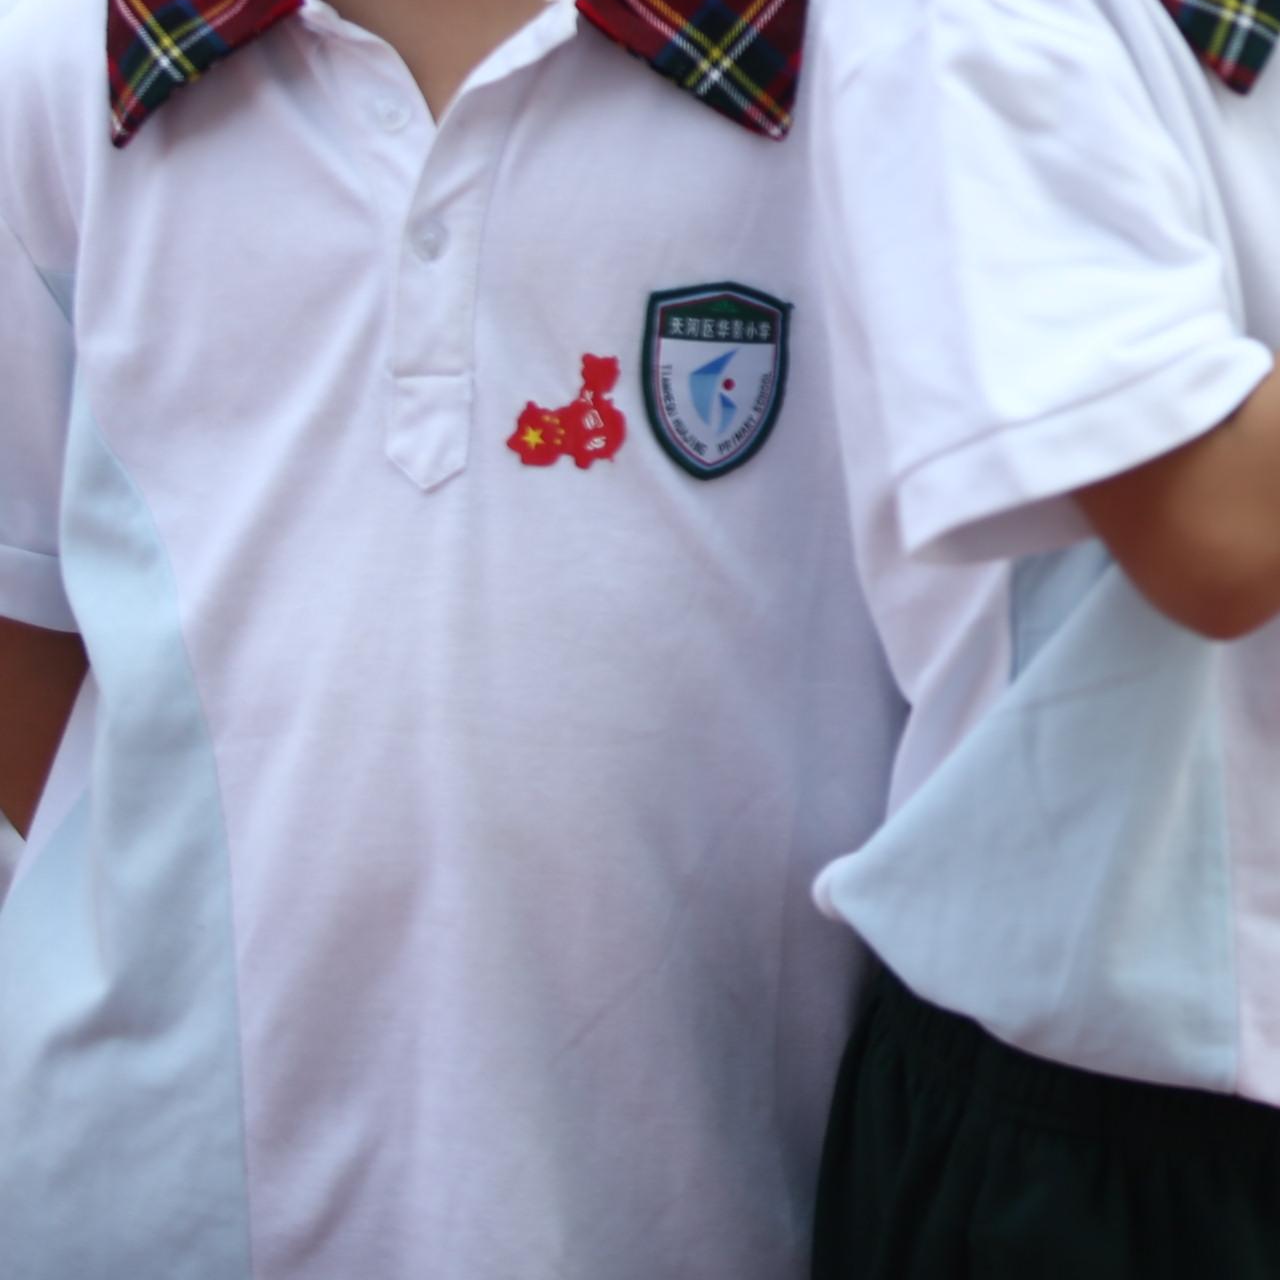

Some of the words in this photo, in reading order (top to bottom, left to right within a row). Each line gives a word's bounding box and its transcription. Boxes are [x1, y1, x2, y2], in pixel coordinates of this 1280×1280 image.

[670, 317, 772, 340] 天河区华景小学
[717, 415, 757, 455] PRIMARY
